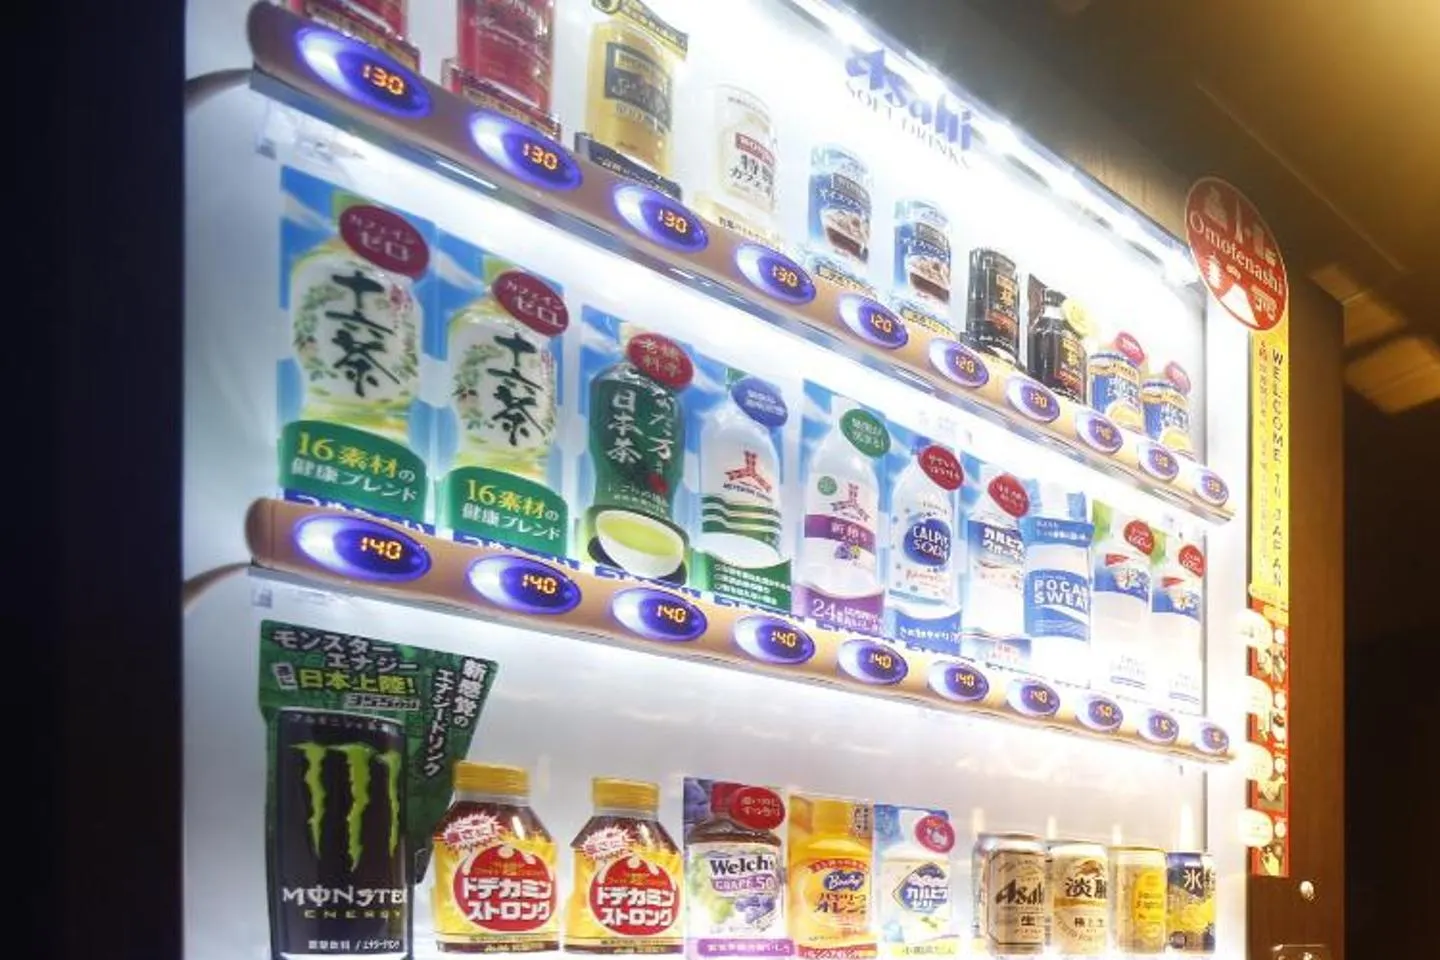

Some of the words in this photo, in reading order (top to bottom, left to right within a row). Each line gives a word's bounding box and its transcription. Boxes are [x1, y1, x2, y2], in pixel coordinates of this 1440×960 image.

[363, 64, 404, 95] 130
[846, 48, 971, 150] Asahi
[523, 143, 558, 170] 130
[659, 208, 687, 234] 130
[361, 231, 409, 262] ゼロ
[1190, 210, 1283, 296] Omotenashi
[773, 266, 798, 288] 130
[516, 297, 564, 328] ゼロ
[871, 310, 893, 334] 120
[325, 270, 400, 397] 十六茶
[955, 350, 976, 374] 120
[487, 333, 546, 446] 十六茶
[1272, 349, 1284, 462] WELCOME
[606, 389, 644, 463] 日本茶
[299, 432, 415, 483] 16素材の
[292, 458, 418, 502] 健康ブレンド
[467, 480, 559, 521] 16素材の
[462, 503, 560, 541] 健康ブレンド
[361, 536, 402, 560] 140
[522, 573, 557, 594] 140
[657, 605, 687, 624] 140
[273, 630, 394, 654] モンスター
[771, 629, 798, 648] 140
[327, 652, 417, 672] エナジー
[869, 652, 892, 669] 140
[955, 672, 975, 687] 140
[424, 669, 454, 776] エナジードリンク
[463, 877, 552, 899] ドデカミン
[597, 888, 674, 906] ドデカミン
[467, 901, 550, 921] ストロング
[601, 908, 672, 926] ストロング
